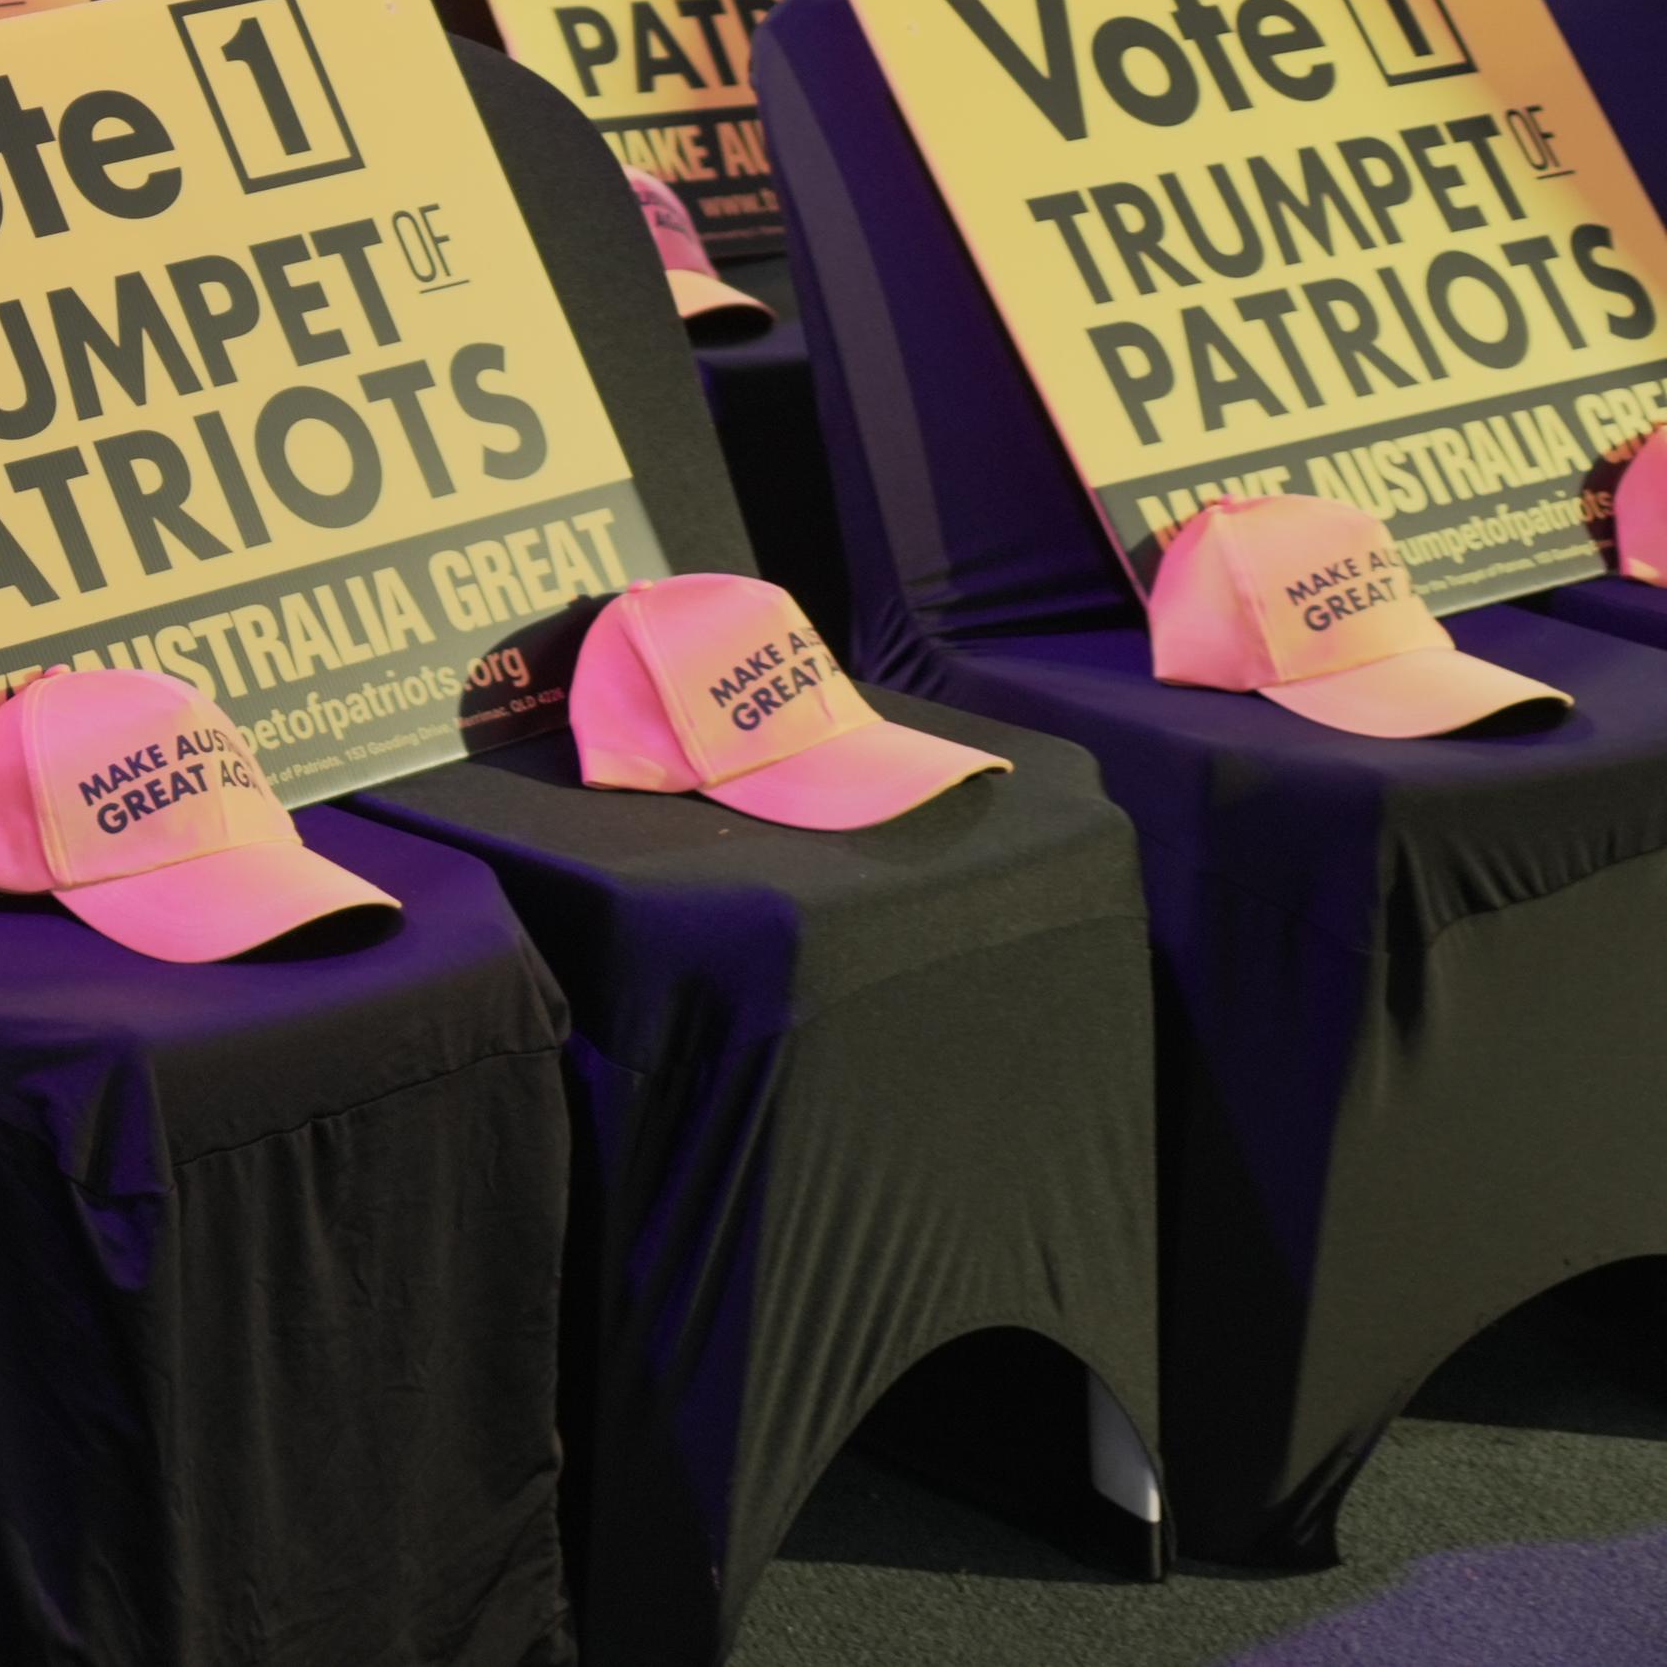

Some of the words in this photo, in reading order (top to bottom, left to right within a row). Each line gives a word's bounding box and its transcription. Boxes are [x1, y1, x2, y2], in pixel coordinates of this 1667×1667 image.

[1026, 114, 1528, 305] TRUMPET
[1505, 106, 1560, 172] OF
[391, 204, 453, 284] OF
[1086, 223, 1657, 447] PATRIOTS
[1306, 404, 1592, 521] AUSTRALIA
[428, 508, 631, 632] GREAT
[1286, 555, 1361, 606] MAKE
[1303, 575, 1400, 632] GREAT
[709, 642, 786, 708] MAKE
[732, 657, 823, 732] GREAT
[78, 744, 168, 806] MAKE
[97, 763, 208, 834] GREAT
